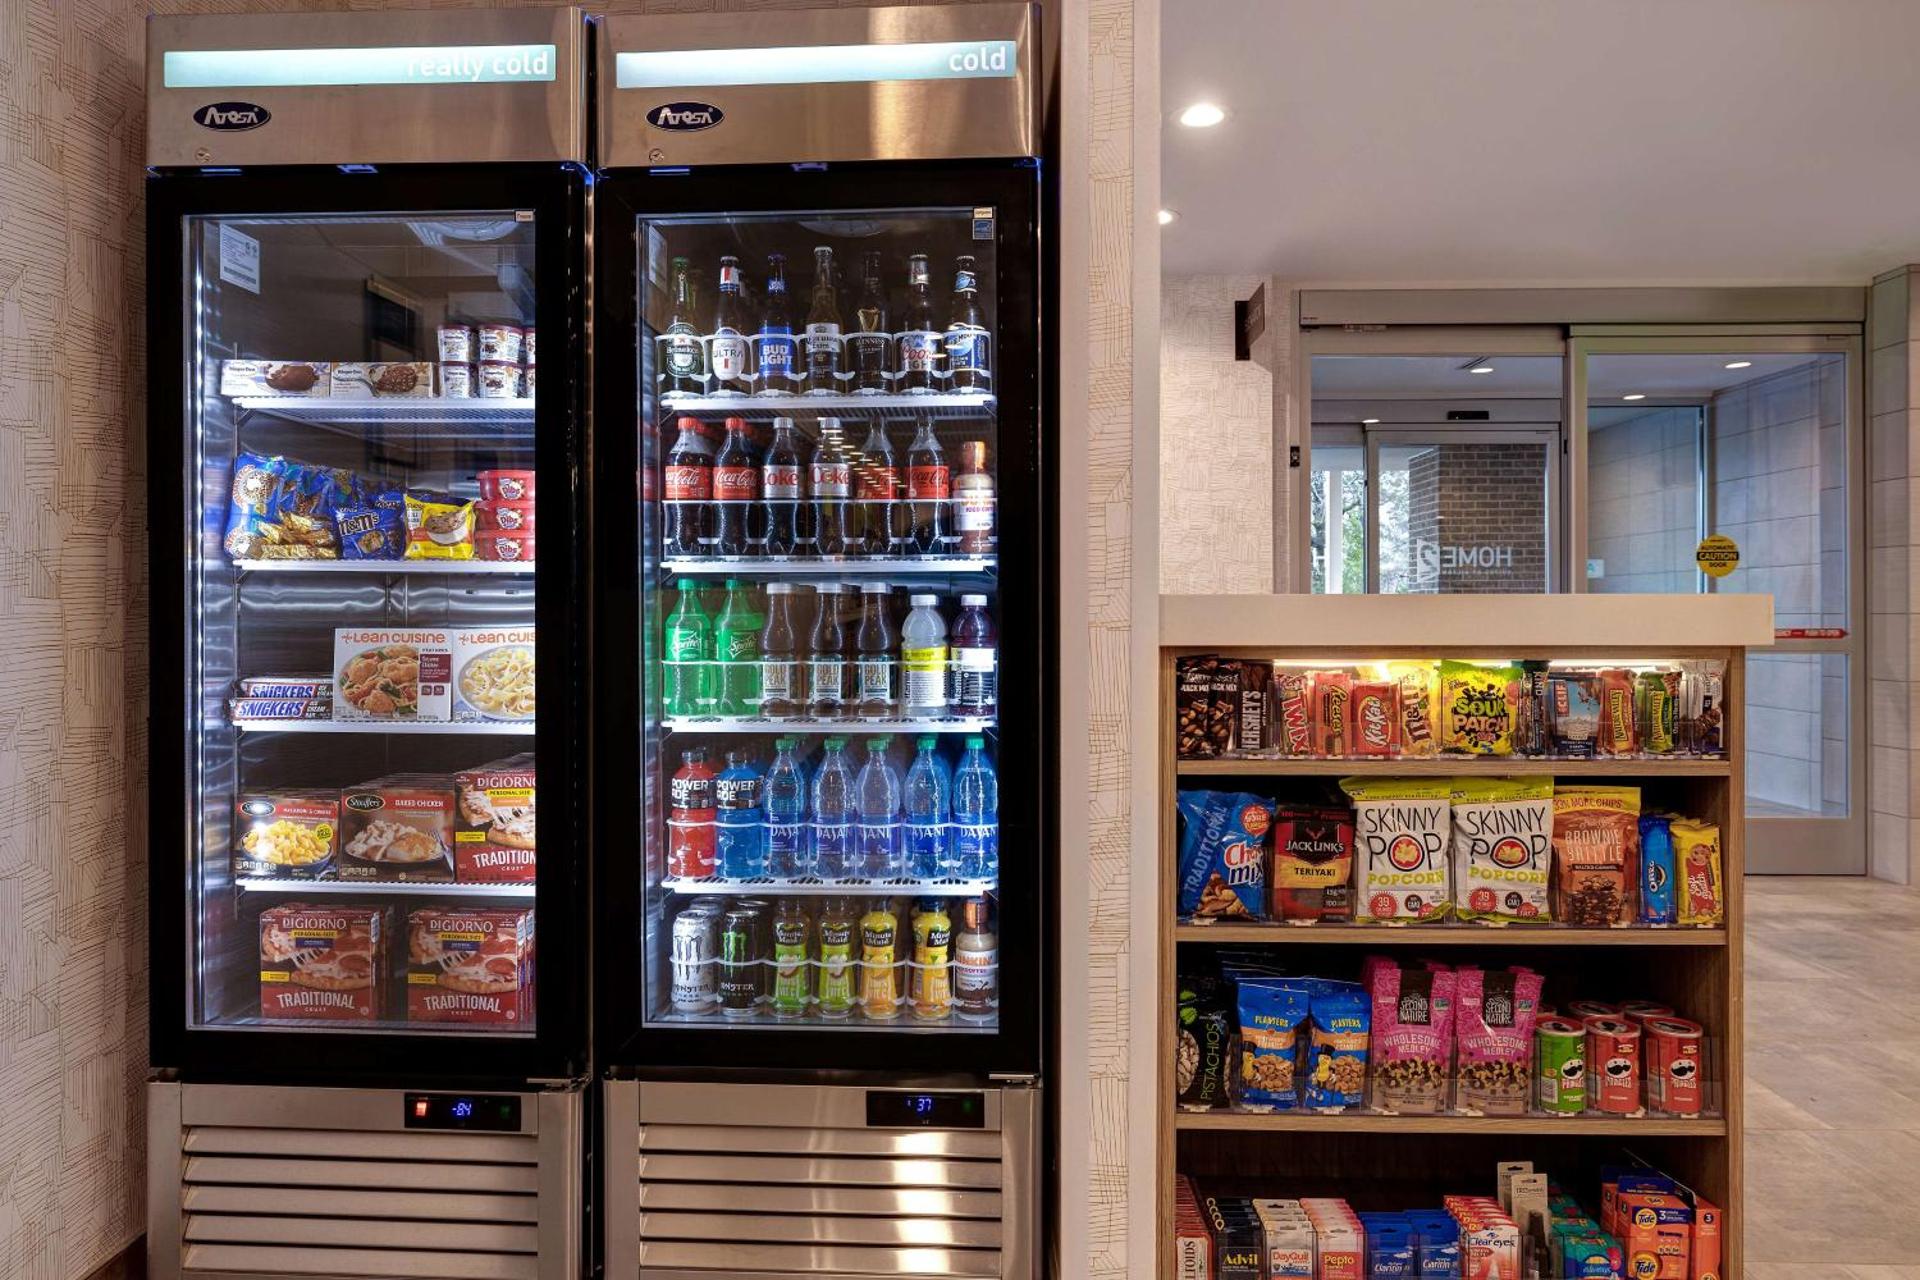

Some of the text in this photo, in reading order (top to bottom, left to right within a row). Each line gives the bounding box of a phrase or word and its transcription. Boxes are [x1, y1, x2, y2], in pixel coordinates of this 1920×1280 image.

[949, 46, 1006, 72] cold
[407, 51, 548, 81] really cold
[763, 345, 789, 355] BUD
[760, 355, 792, 365] LIGHT
[1699, 552, 1737, 560] CAUTION
[730, 639, 757, 651] Sprite
[765, 664, 787, 674] GOLD
[816, 664, 840, 675] GOLD
[864, 664, 887, 674] GOLD
[765, 674, 787, 686] PEAK
[816, 675, 840, 686] PEAK
[864, 675, 887, 686] PEAK
[250, 685, 314, 699] SNICKERS
[240, 701, 305, 716] SNICKERS
[1456, 698, 1506, 717] SOUR
[1242, 690, 1261, 750] HERSHEY'S
[1282, 696, 1310, 752] TWIX
[1452, 715, 1510, 733] PATCH
[716, 779, 755, 791] POWER
[1565, 829, 1622, 846] BROWNIE
[1183, 806, 1228, 893] TRADITIONAL
[1285, 840, 1313, 852] JACK
[1366, 833, 1442, 872] POP
[1470, 834, 1547, 870] POP
[1294, 867, 1336, 877] TERIYAKI
[1368, 869, 1445, 885] POPCORN
[282, 917, 347, 929] DIGIORNO
[430, 919, 494, 932] DIGIORNO
[864, 931, 892, 939] Minute
[275, 991, 355, 1010] TRADITIONAL
[423, 994, 501, 1013] TRADITIONAL
[1399, 999, 1428, 1011] SECOND
[1254, 1015, 1289, 1028] PLANTERS
[1400, 1010, 1428, 1023] NATURE
[1384, 1033, 1442, 1050] WHOLESOME
[1467, 1036, 1528, 1051] WHOLESOME
[1398, 1045, 1431, 1055] MEDLEY
[1483, 1047, 1515, 1056] MEDLEY
[1200, 1022, 1221, 1100] PISTACHIOS
[917, 1098, 932, 1112] 37
[1638, 1210, 1667, 1224] Tide 3
[1706, 1214, 1712, 1222] 3
[1493, 1238, 1516, 1249] eyes
[1185, 1240, 1196, 1280] LTOIDS
[1224, 1253, 1258, 1265] Advil
[1272, 1251, 1309, 1263] DayQuil
[1324, 1255, 1355, 1265] Pepto
[1635, 1260, 1656, 1273] Tide
